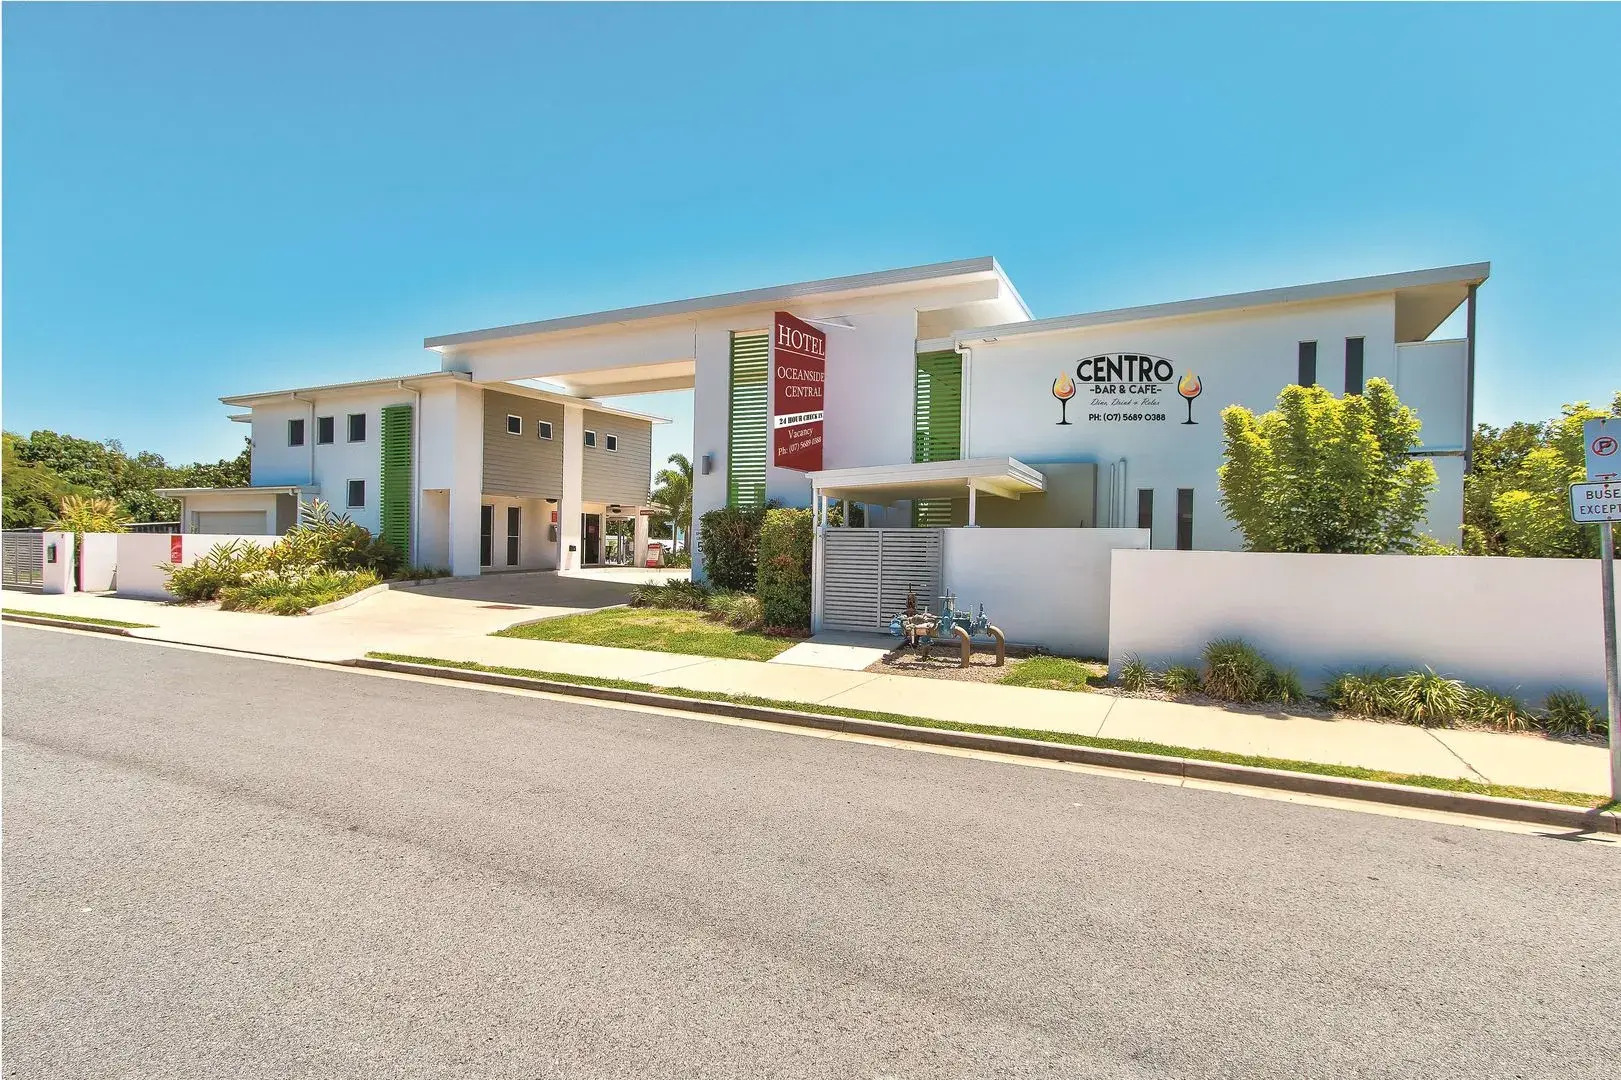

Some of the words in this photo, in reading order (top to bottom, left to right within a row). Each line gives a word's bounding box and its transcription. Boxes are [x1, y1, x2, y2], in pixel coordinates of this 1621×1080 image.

[778, 324, 825, 356] HOTEL
[1076, 354, 1174, 382] CENTRO
[777, 366, 825, 382] OCEANSIDE
[785, 385, 822, 397] CENTRAL
[1119, 384, 1126, 394] &
[1111, 397, 1132, 406] Drink
[1140, 397, 1160, 406] Relax
[779, 417, 787, 425] 24
[787, 415, 803, 424] HOUR
[803, 413, 818, 422] CHECK
[1088, 413, 1102, 421] PH:
[1103, 413, 1121, 422] (07)
[1122, 413, 1143, 421] 5689
[1144, 413, 1166, 421] 0388
[788, 428, 813, 438] Vacancy
[778, 447, 788, 457] Ph:
